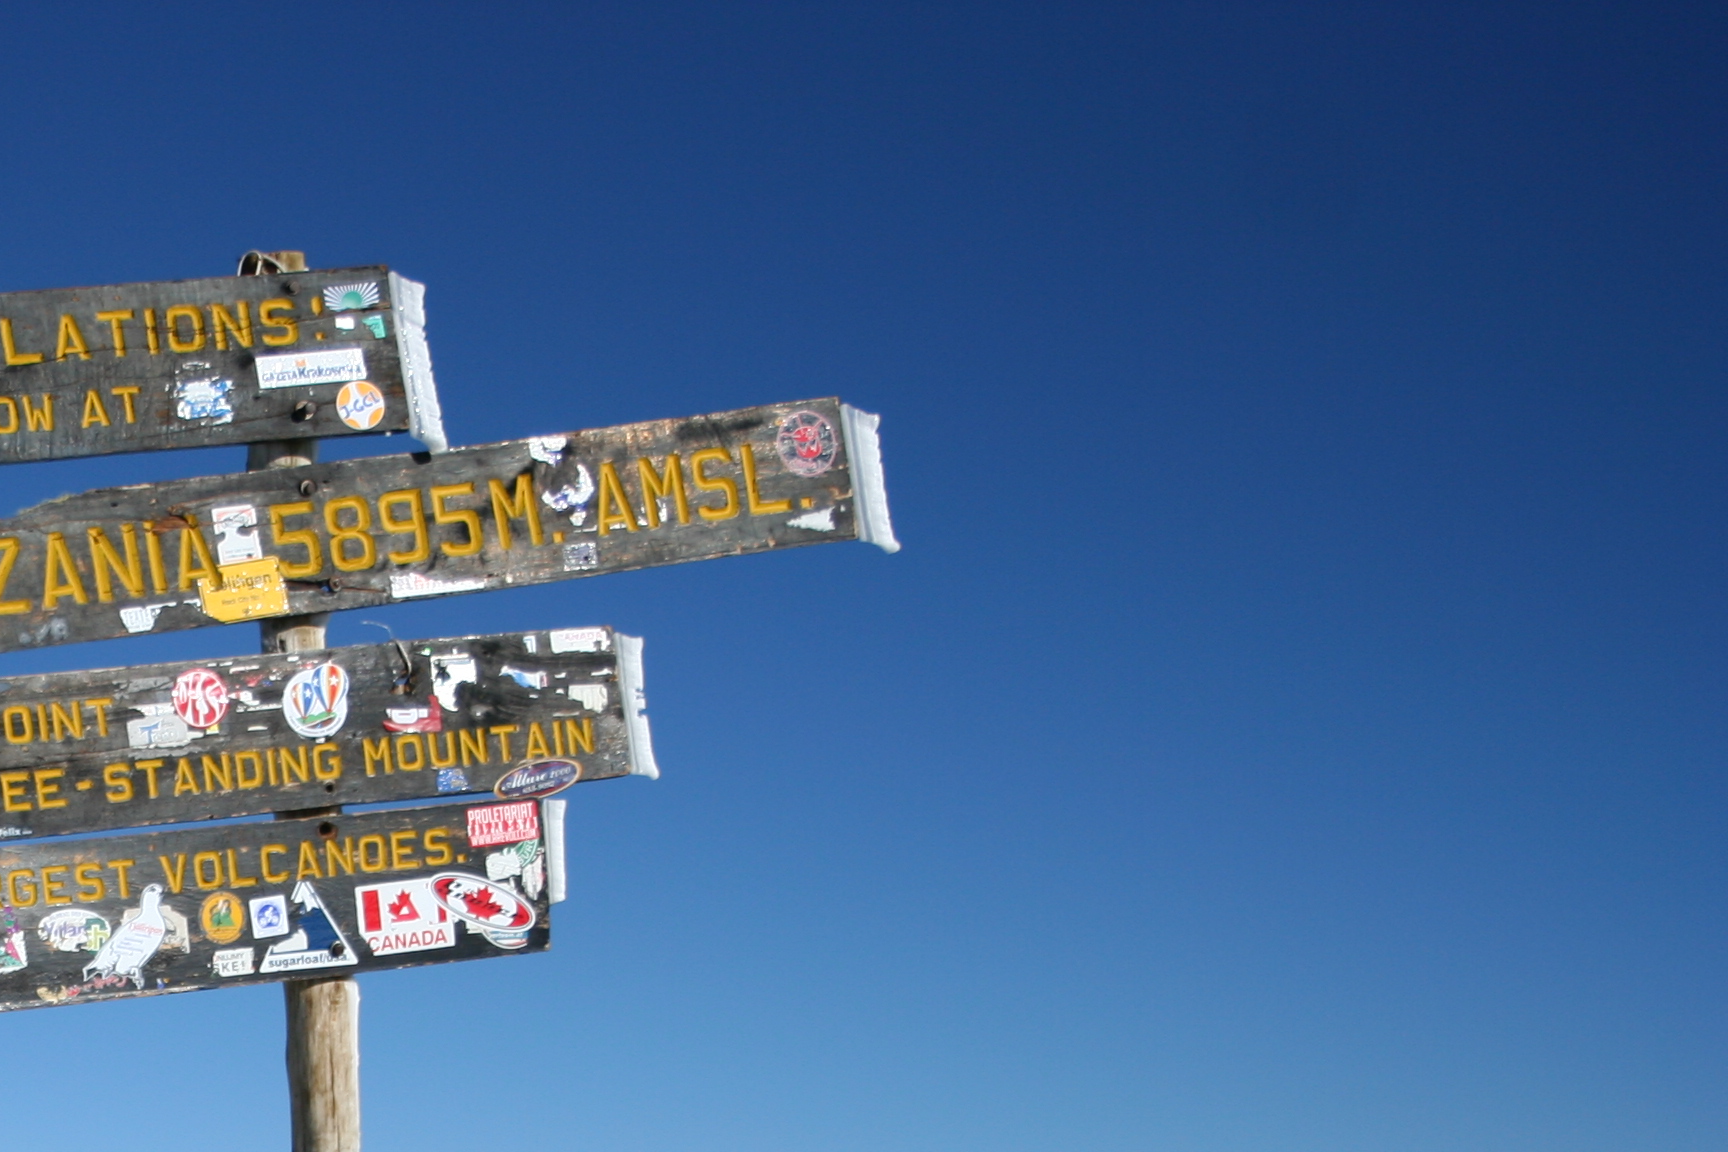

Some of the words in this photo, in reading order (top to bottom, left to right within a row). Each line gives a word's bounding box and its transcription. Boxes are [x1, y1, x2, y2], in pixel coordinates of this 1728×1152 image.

[82, 385, 141, 428] AT
[268, 472, 566, 579] 5895M.
[598, 443, 814, 536] AMSL.
[362, 717, 597, 775] MOUNTAIN
[467, 802, 534, 824] PROLETARIAT
[159, 826, 467, 895] VOLCANOES.
[367, 928, 448, 951] CANADA
